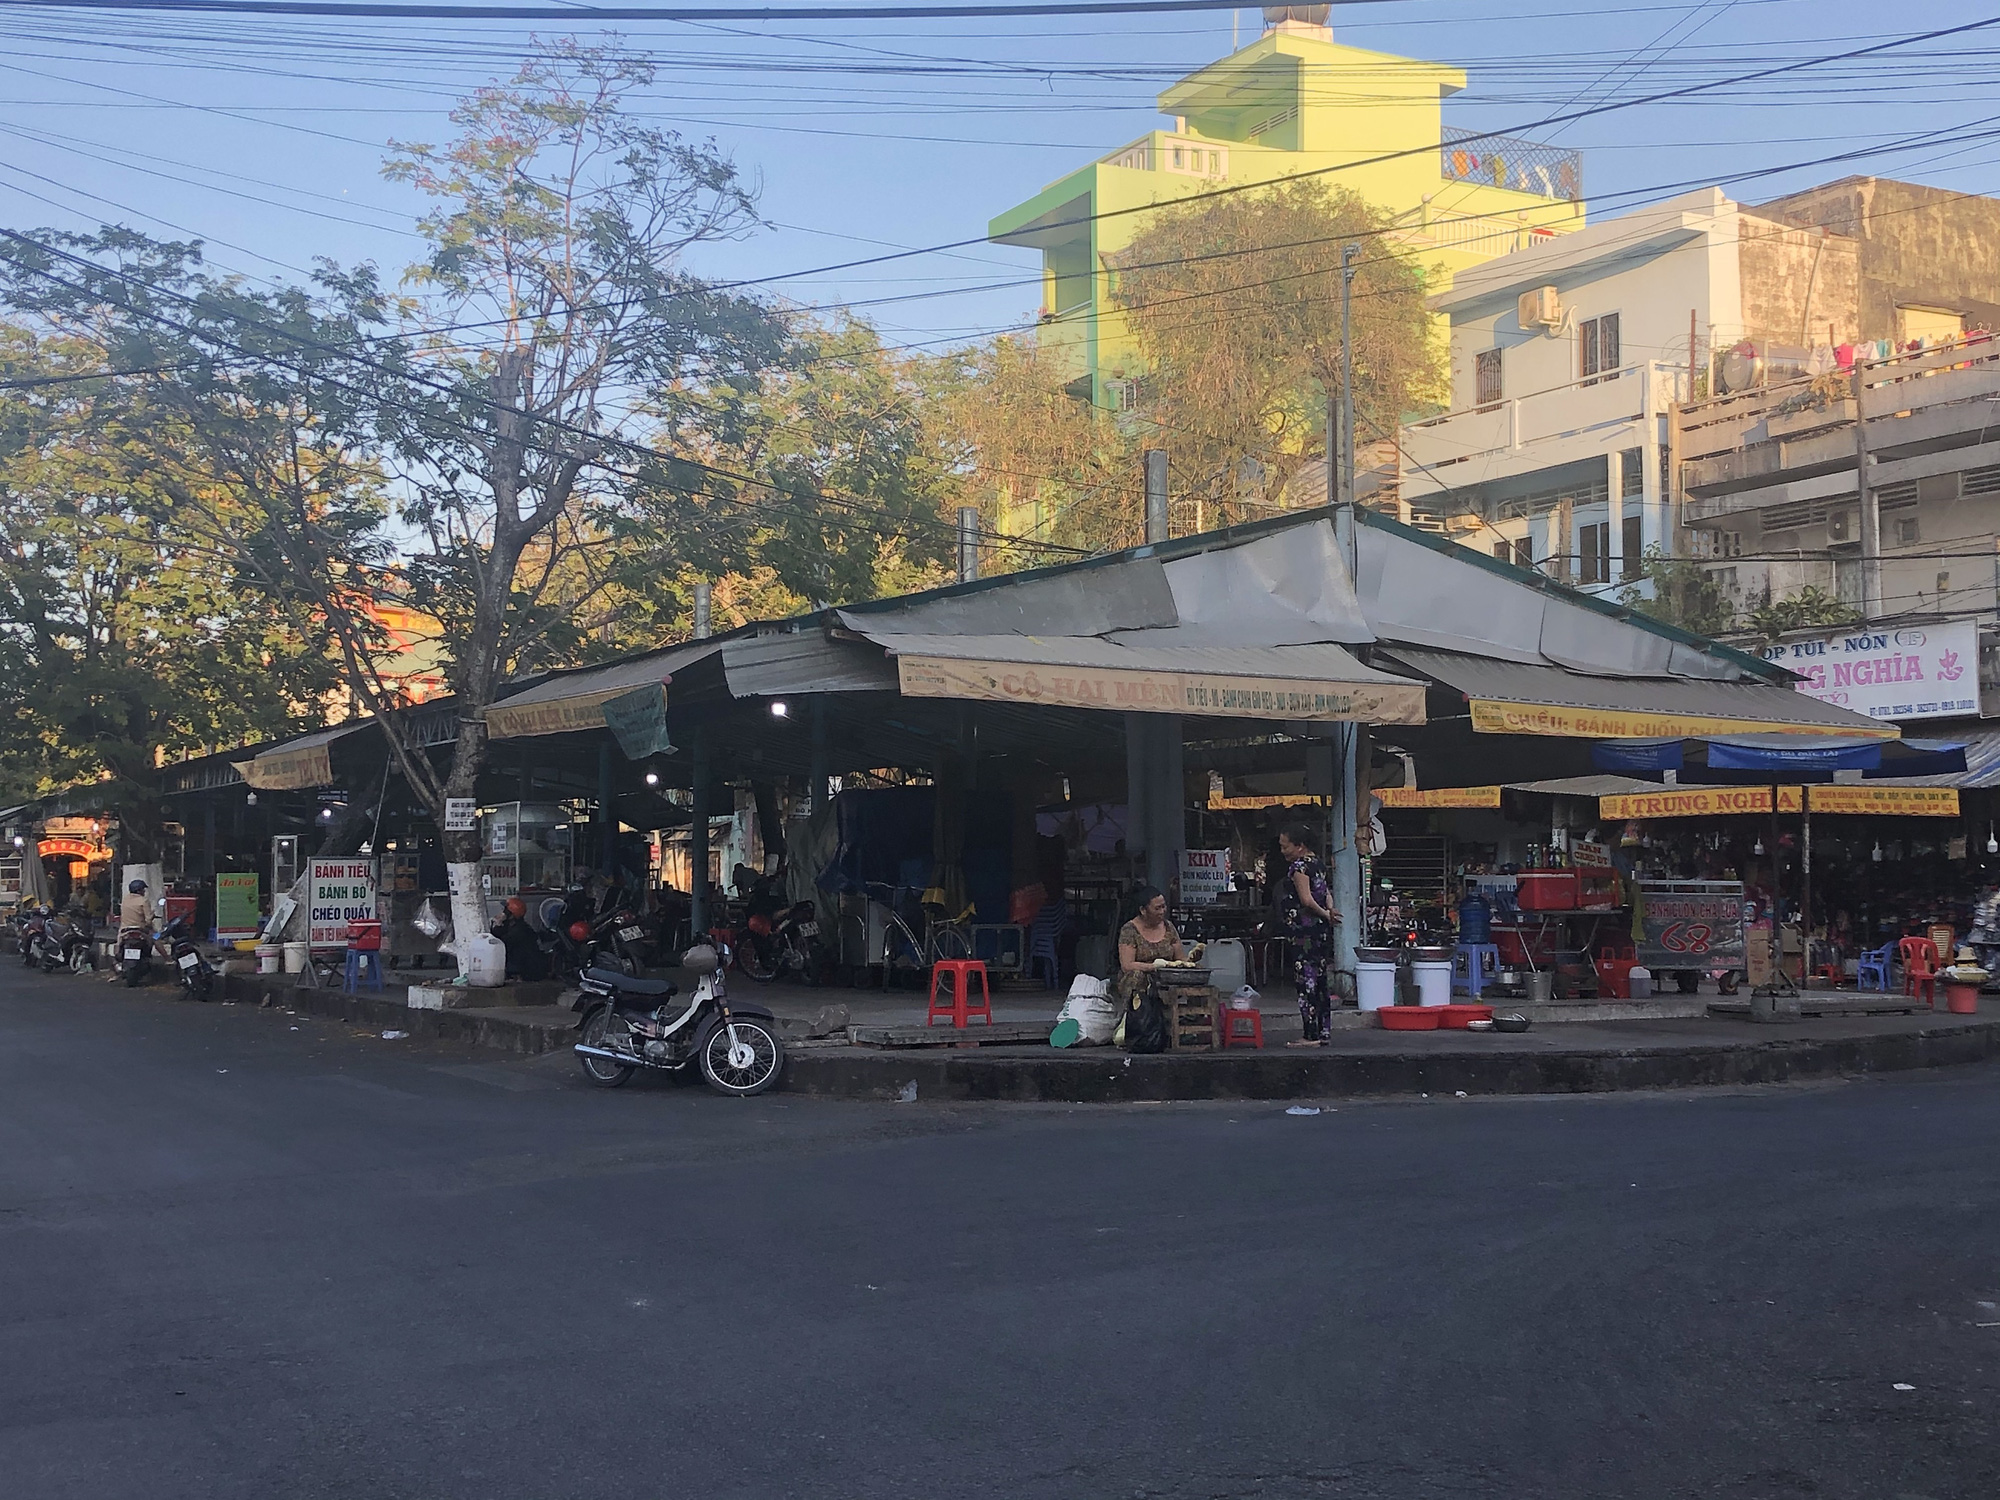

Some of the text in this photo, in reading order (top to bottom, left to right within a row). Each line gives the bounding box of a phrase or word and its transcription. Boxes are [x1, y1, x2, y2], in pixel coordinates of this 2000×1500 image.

[1761, 645, 1787, 661] OP
[1833, 651, 1924, 687] NGHĨA
[1575, 716, 1626, 736] BÁNH
[1632, 796, 1710, 814] TRUNG
[1187, 852, 1217, 867] KIM
[315, 862, 344, 879] BÁNH
[319, 883, 348, 899] BÁNH
[1660, 921, 1713, 955] 68
